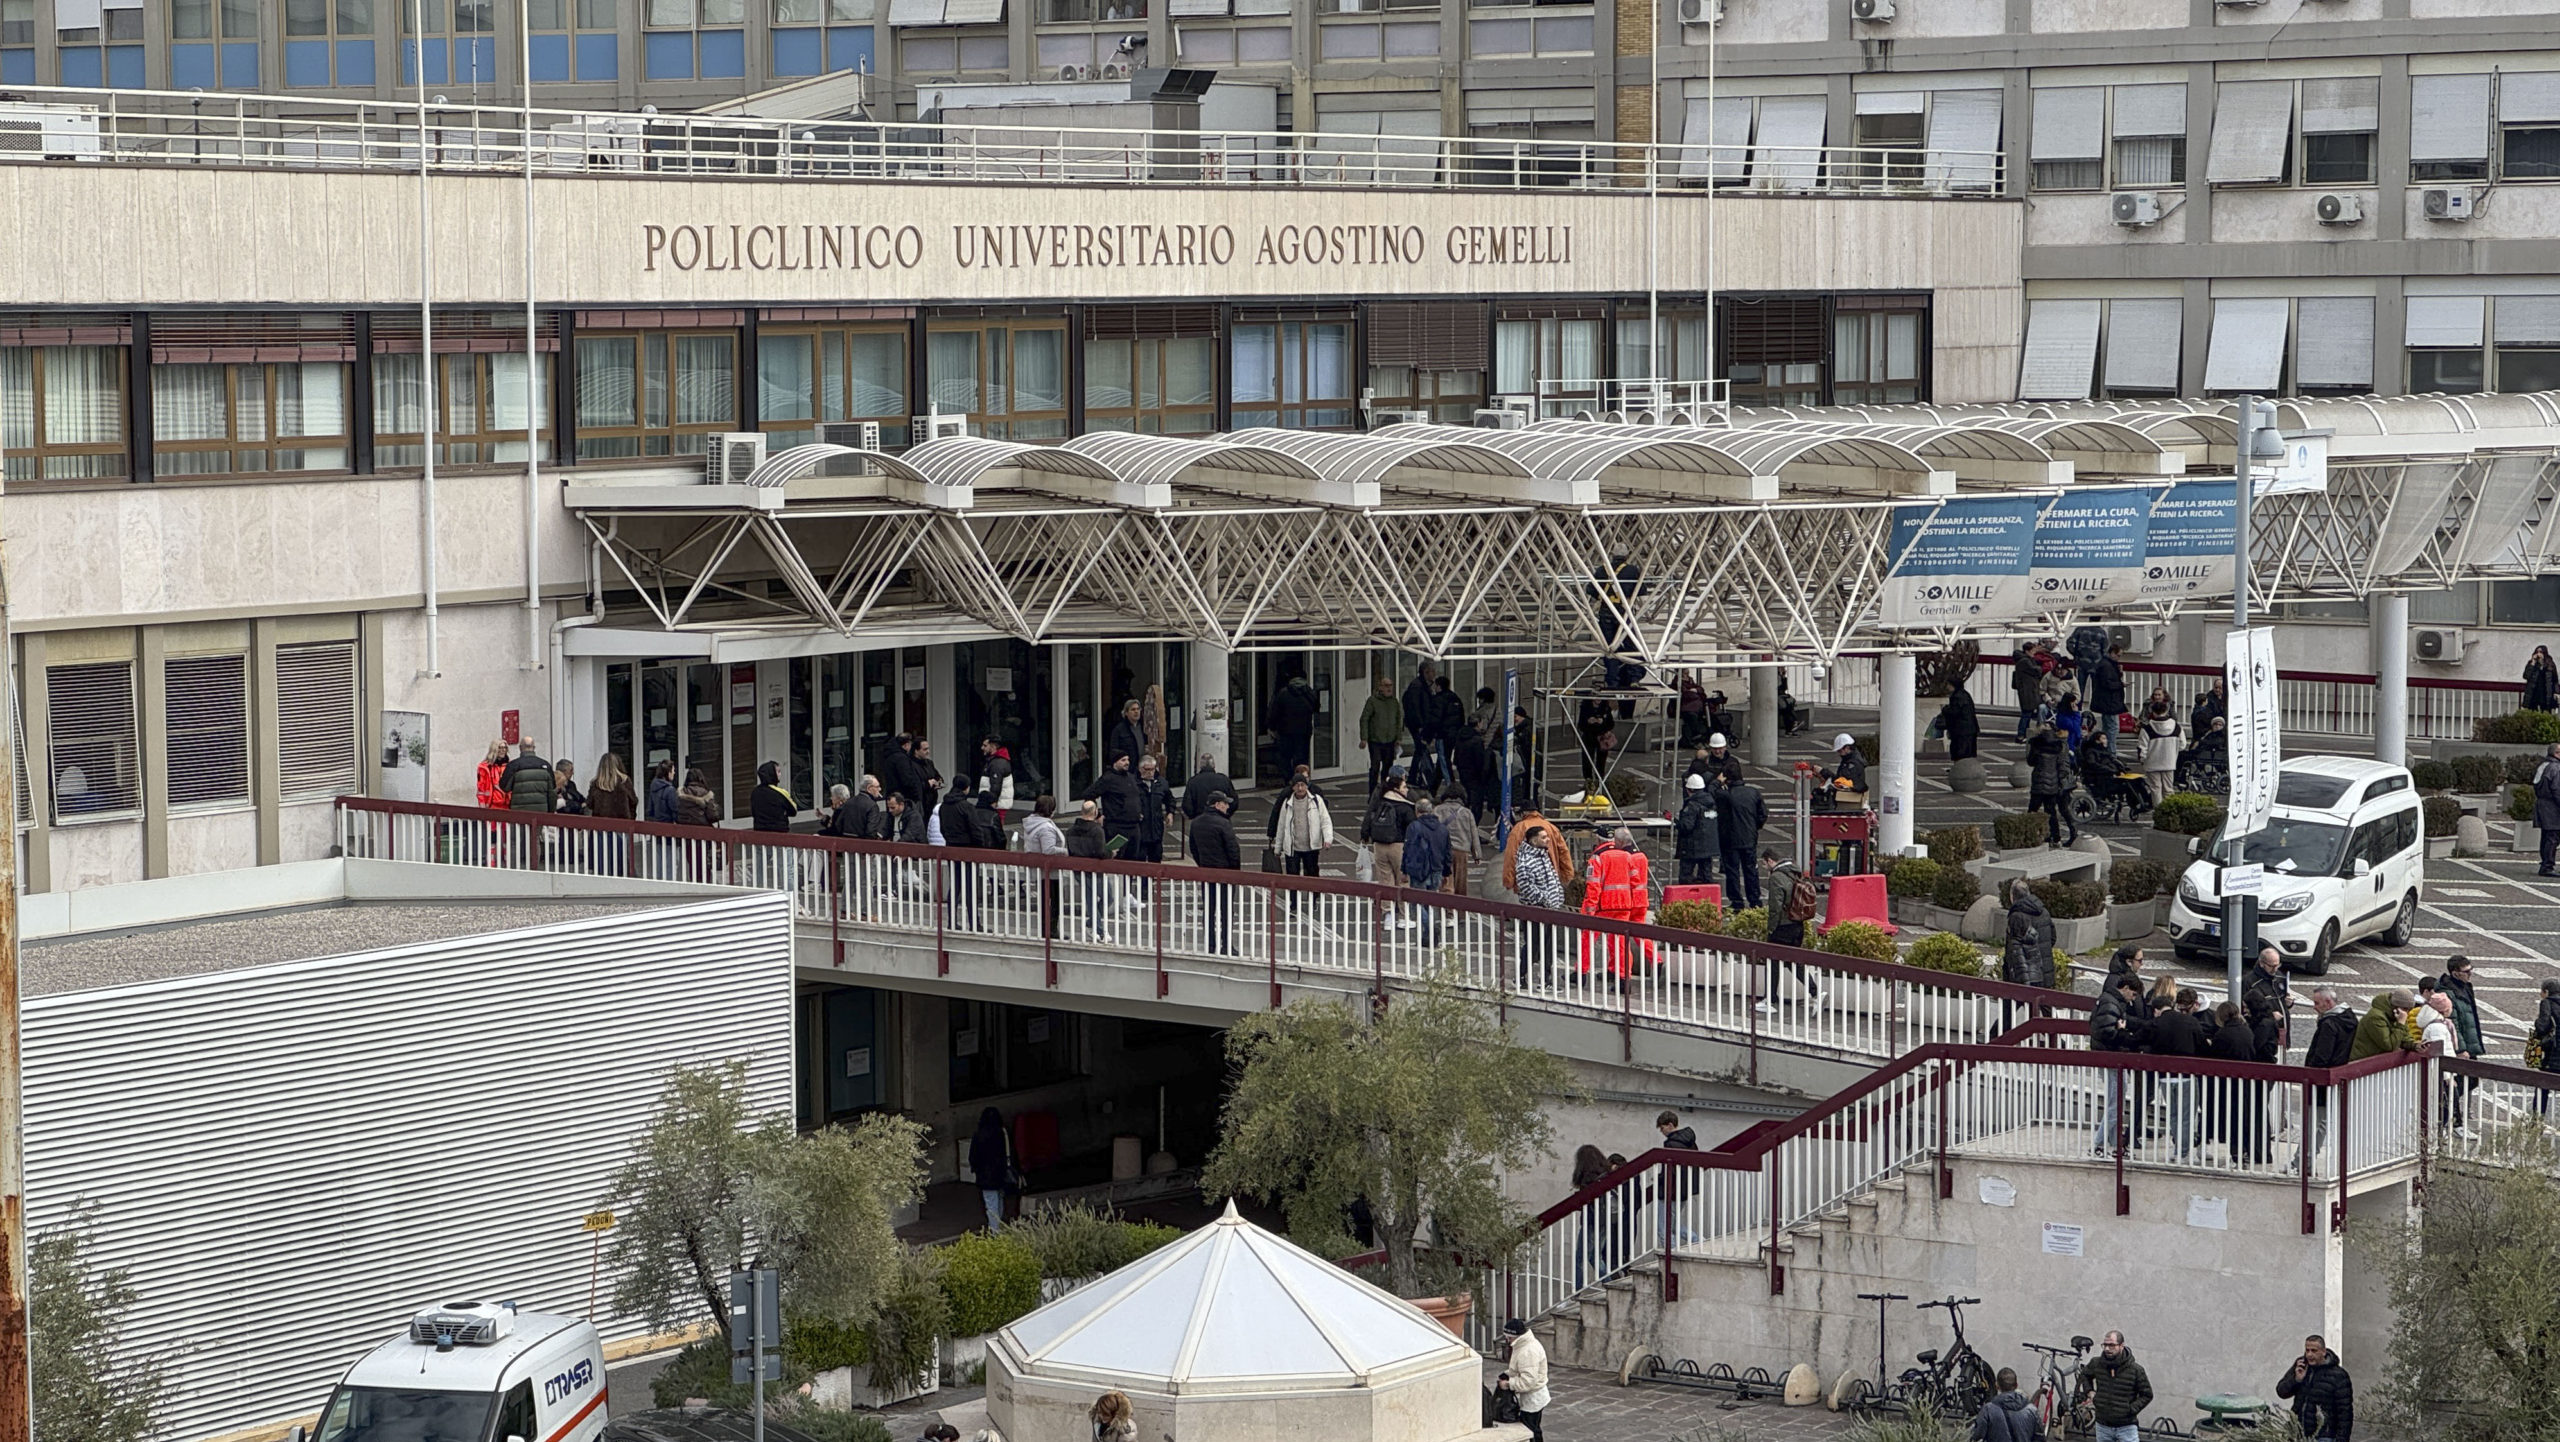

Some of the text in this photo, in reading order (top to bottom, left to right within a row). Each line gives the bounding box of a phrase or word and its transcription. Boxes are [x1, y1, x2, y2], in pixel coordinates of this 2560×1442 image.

[643, 225, 1571, 271] POLICLINICO UNIVERSITARIO AGOSTINO GEMELLI
[2048, 509, 2093, 518] FERMARE
[2094, 508, 2107, 517] LA
[2110, 507, 2139, 517] CURA,
[1903, 516, 2024, 527] NON ERMARE LA SPERANZA,
[2073, 520, 2086, 528] LA
[2088, 519, 2132, 527] RICERCA.
[1969, 527, 2007, 535] RICERCA.
[2141, 583, 2179, 593] Gemelli
[2037, 594, 2078, 604] Gemelli
[1920, 604, 1961, 615] Gemelli
[2232, 714, 2243, 819] Gemelli
[2255, 709, 2268, 813] Gemelli
